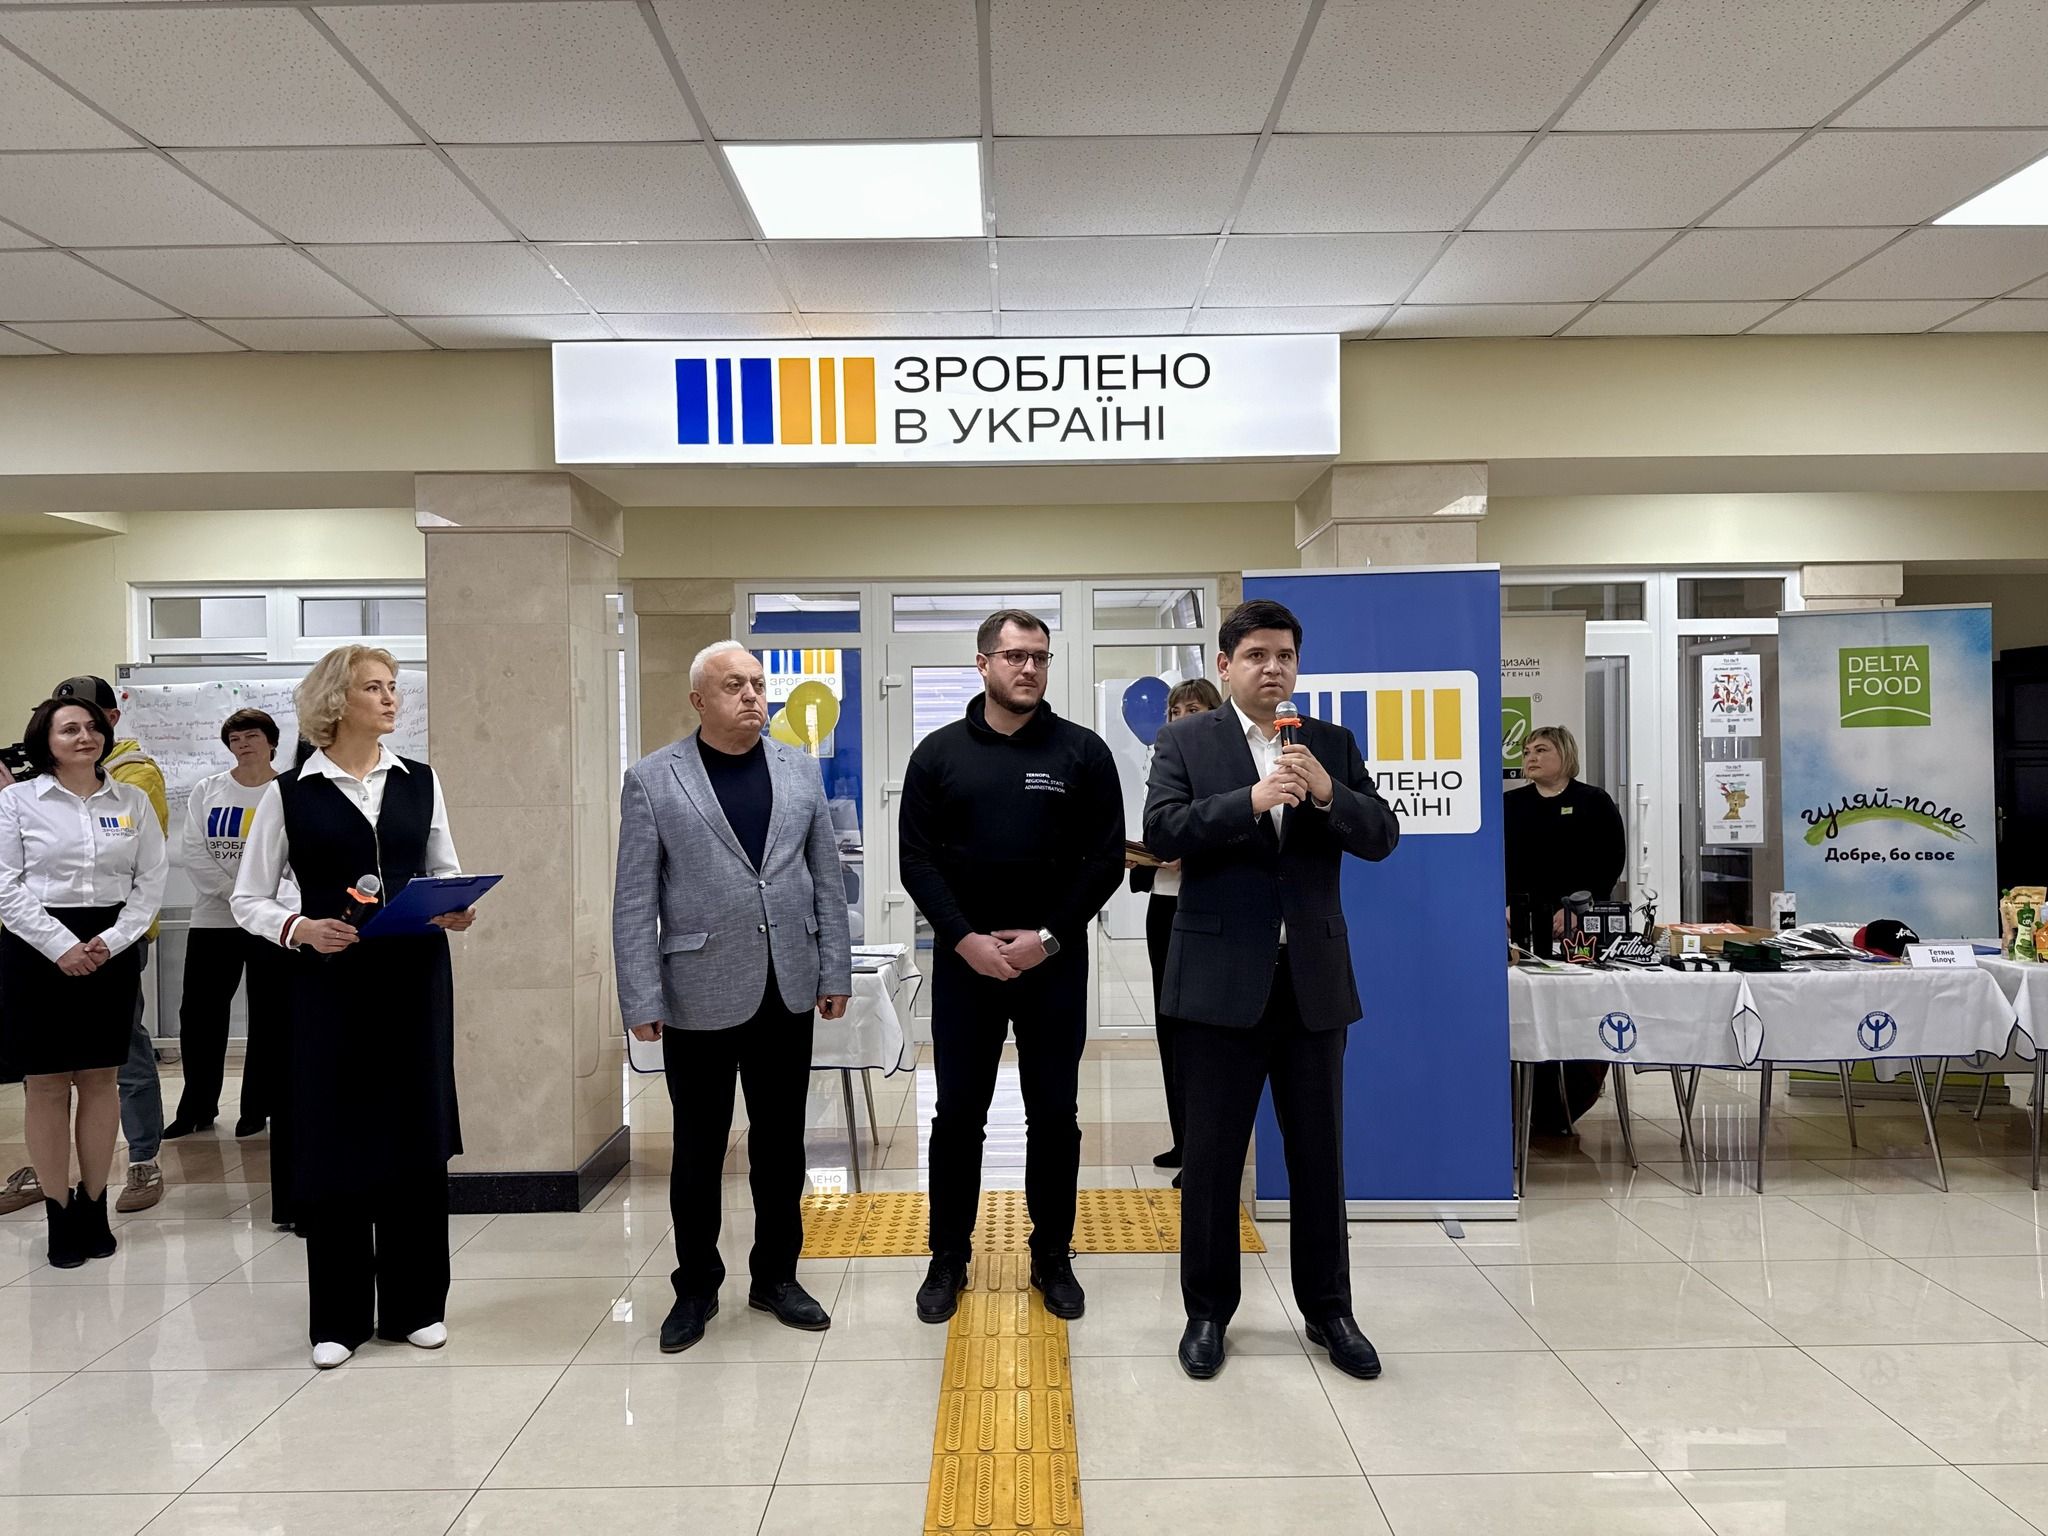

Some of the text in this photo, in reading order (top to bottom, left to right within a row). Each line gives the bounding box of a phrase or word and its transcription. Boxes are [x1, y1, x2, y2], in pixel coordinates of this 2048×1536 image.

[895, 352, 1211, 393] ЗРОБЛЕНО
[895, 396, 1164, 444] В УКРАЇНІ
[1848, 654, 1920, 673] DELTA
[1848, 676, 1922, 696] FOOD
[1375, 771, 1463, 791] ЛЕНО
[1393, 793, 1451, 816] АЇНІ
[209, 841, 246, 850] ЗРОБЛ
[1825, 847, 1955, 865] Добре, бо своє
[1931, 956, 1956, 964] Білоус
